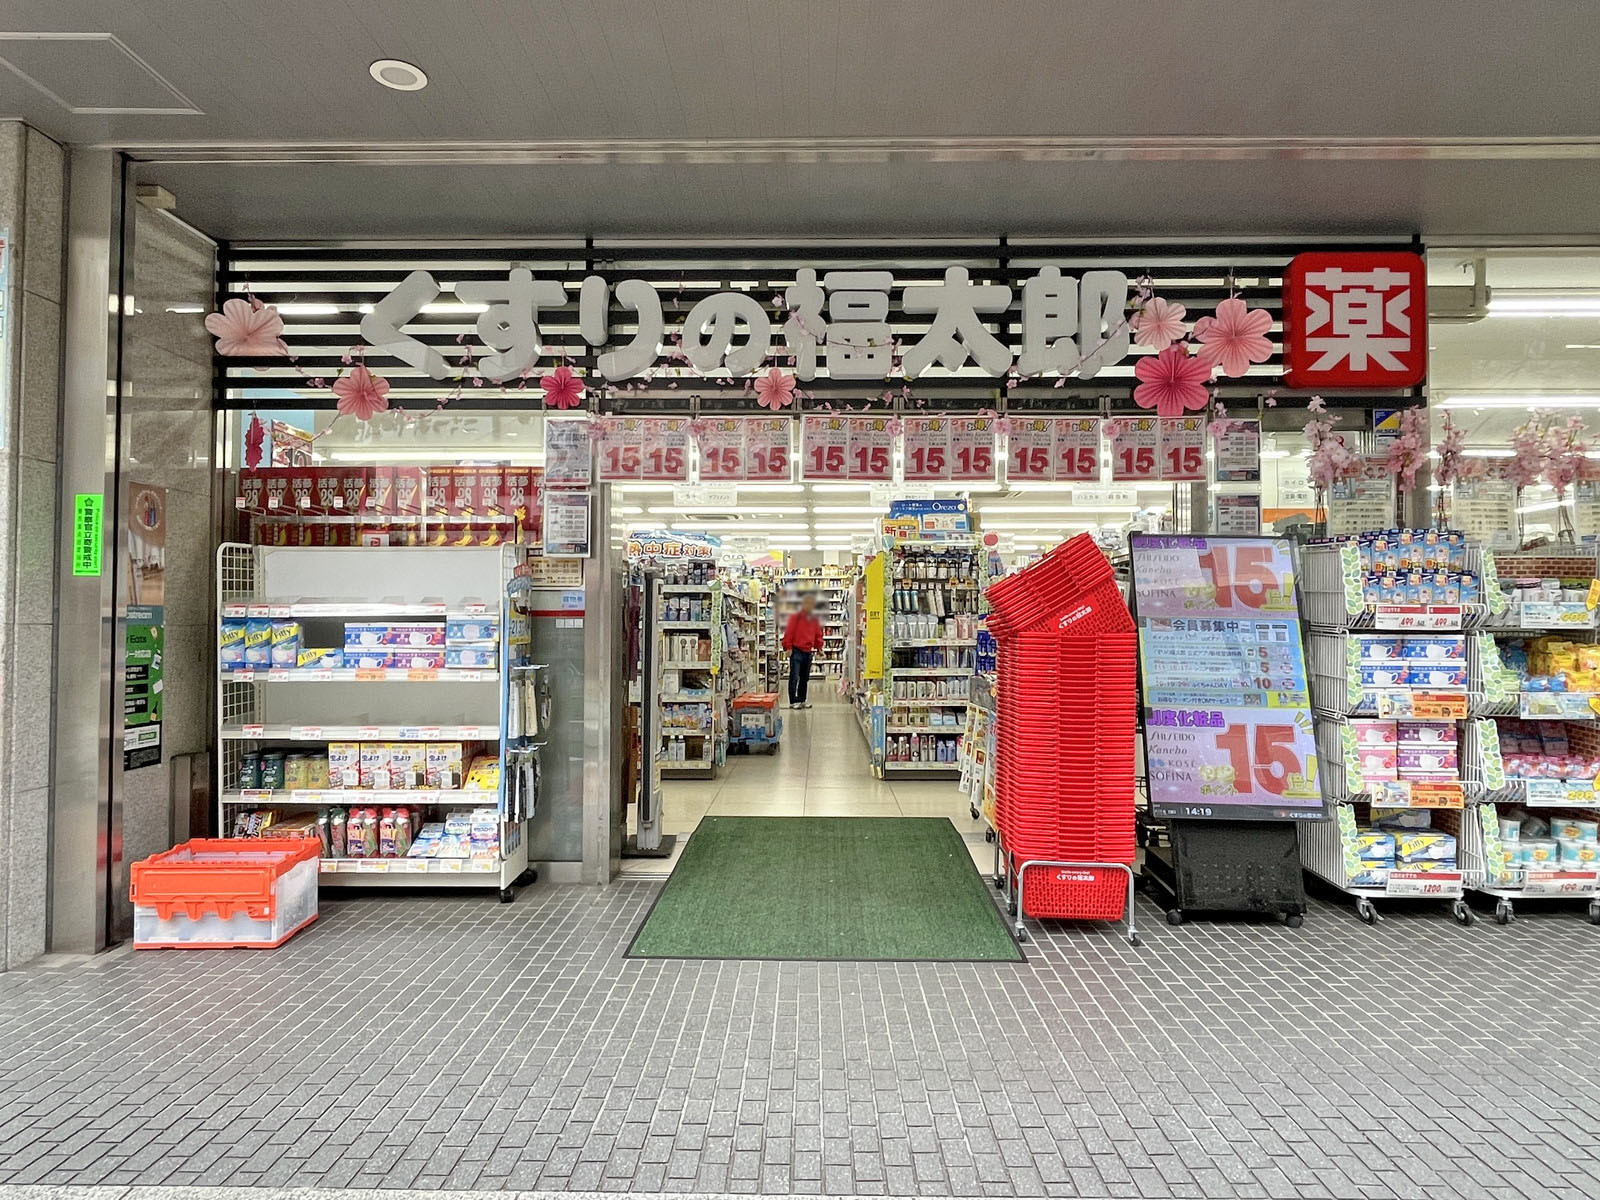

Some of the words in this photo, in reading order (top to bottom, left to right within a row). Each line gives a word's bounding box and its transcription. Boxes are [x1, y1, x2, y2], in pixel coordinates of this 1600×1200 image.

[360, 265, 1130, 381] くすりの福太郎
[1305, 267, 1411, 372] 薬
[607, 447, 641, 473] 15
[649, 447, 685, 473] 15
[706, 447, 741, 473] 15
[753, 447, 787, 473] 15
[811, 447, 844, 473] 15
[855, 447, 889, 473] 15
[912, 447, 945, 473] 15
[958, 447, 991, 473] 15
[1015, 447, 1048, 473] 15
[1062, 447, 1096, 473] 15
[1120, 447, 1154, 473] 15
[1168, 447, 1201, 473] 15
[1199, 545, 1280, 610] 15
[222, 630, 239, 642] Fitty
[246, 631, 264, 643] Fitty
[273, 628, 292, 640] Fitty
[1173, 619, 1239, 632] 会員募集中
[301, 649, 317, 660] Fitty
[1215, 724, 1302, 795] 15
[1150, 771, 1193, 782] SOFINA
[1185, 807, 1212, 816] 14:19
